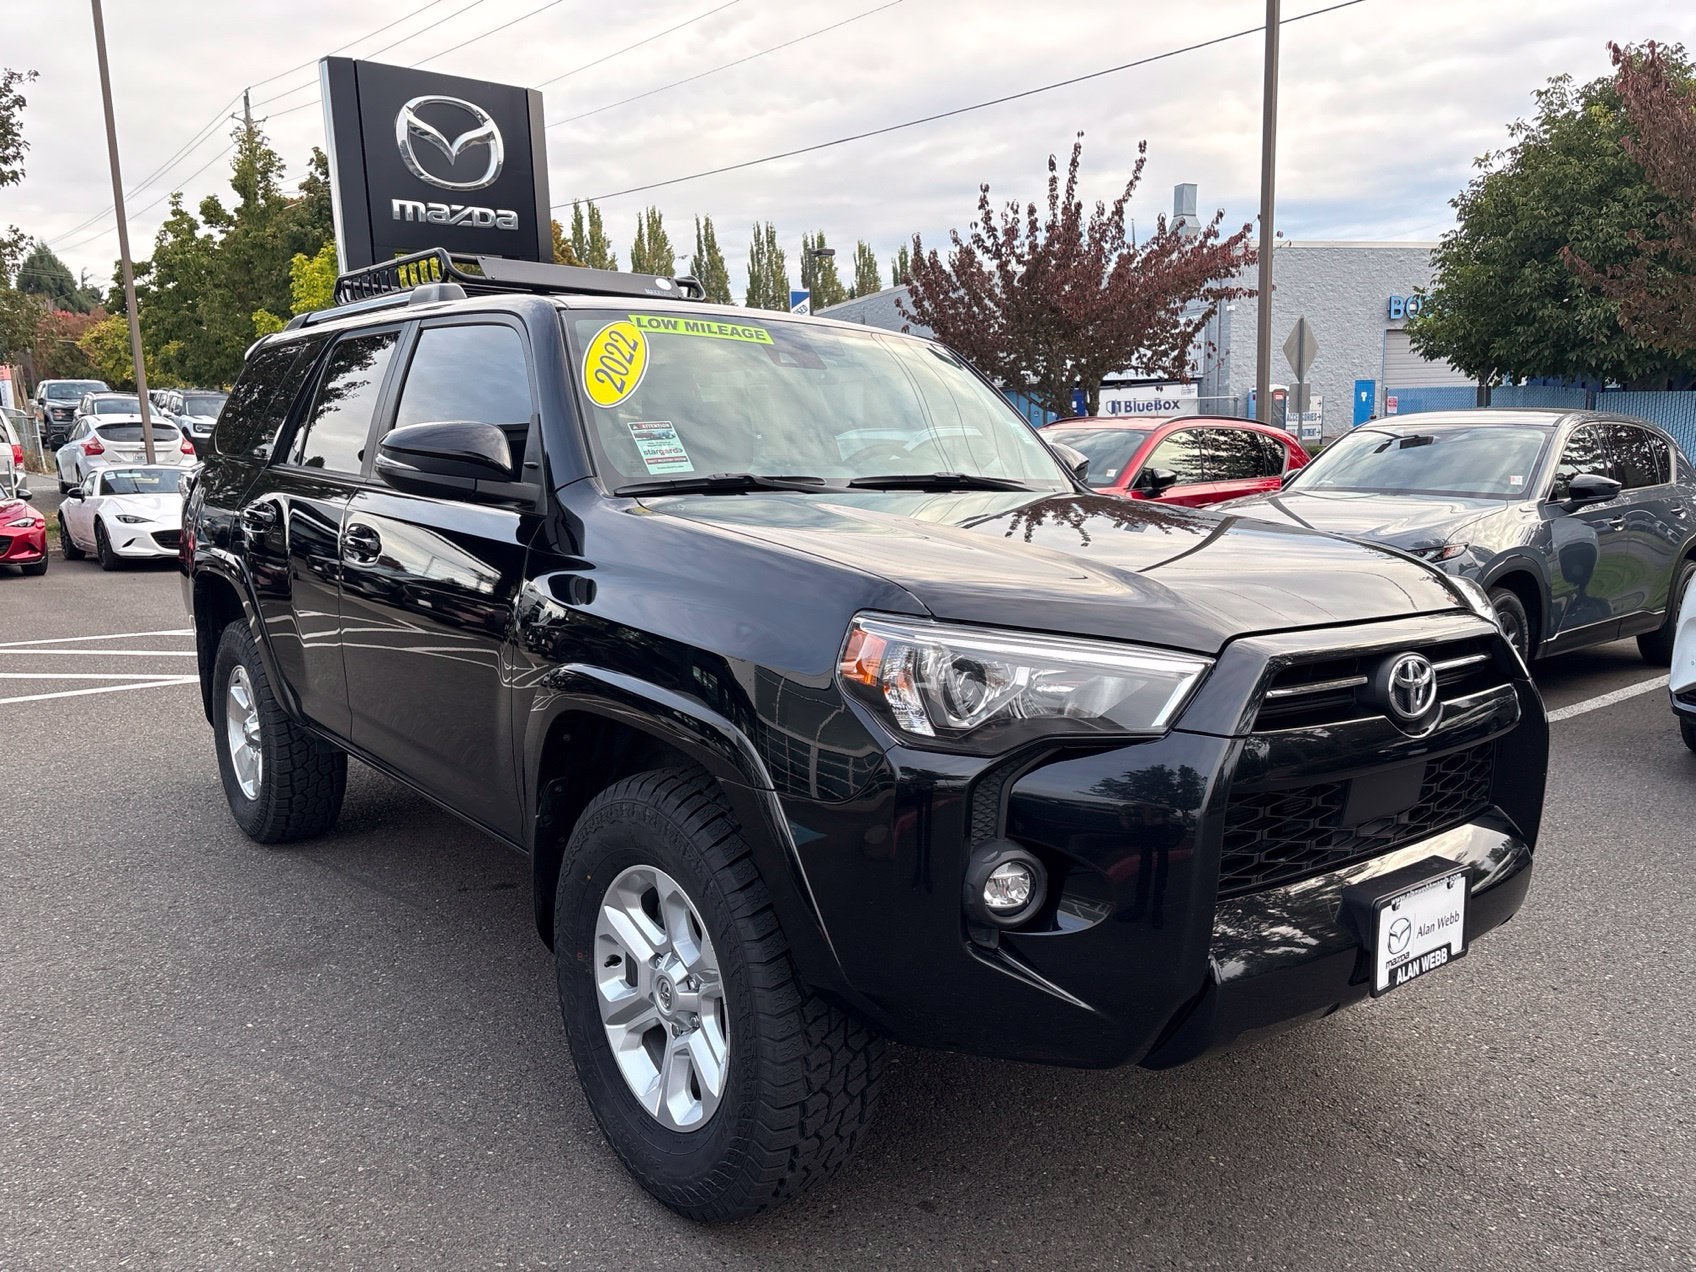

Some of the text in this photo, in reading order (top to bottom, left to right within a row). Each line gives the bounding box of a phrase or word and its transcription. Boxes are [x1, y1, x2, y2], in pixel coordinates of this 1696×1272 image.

[635, 317, 765, 339] LOW MILEAGE
[594, 330, 638, 394] 2022
[1124, 398, 1181, 413] BlueBox
[1287, 412, 1317, 422] ACCEORIES
[1416, 910, 1460, 939] Alan Webb
[1396, 948, 1448, 985] ALAN WEBB
